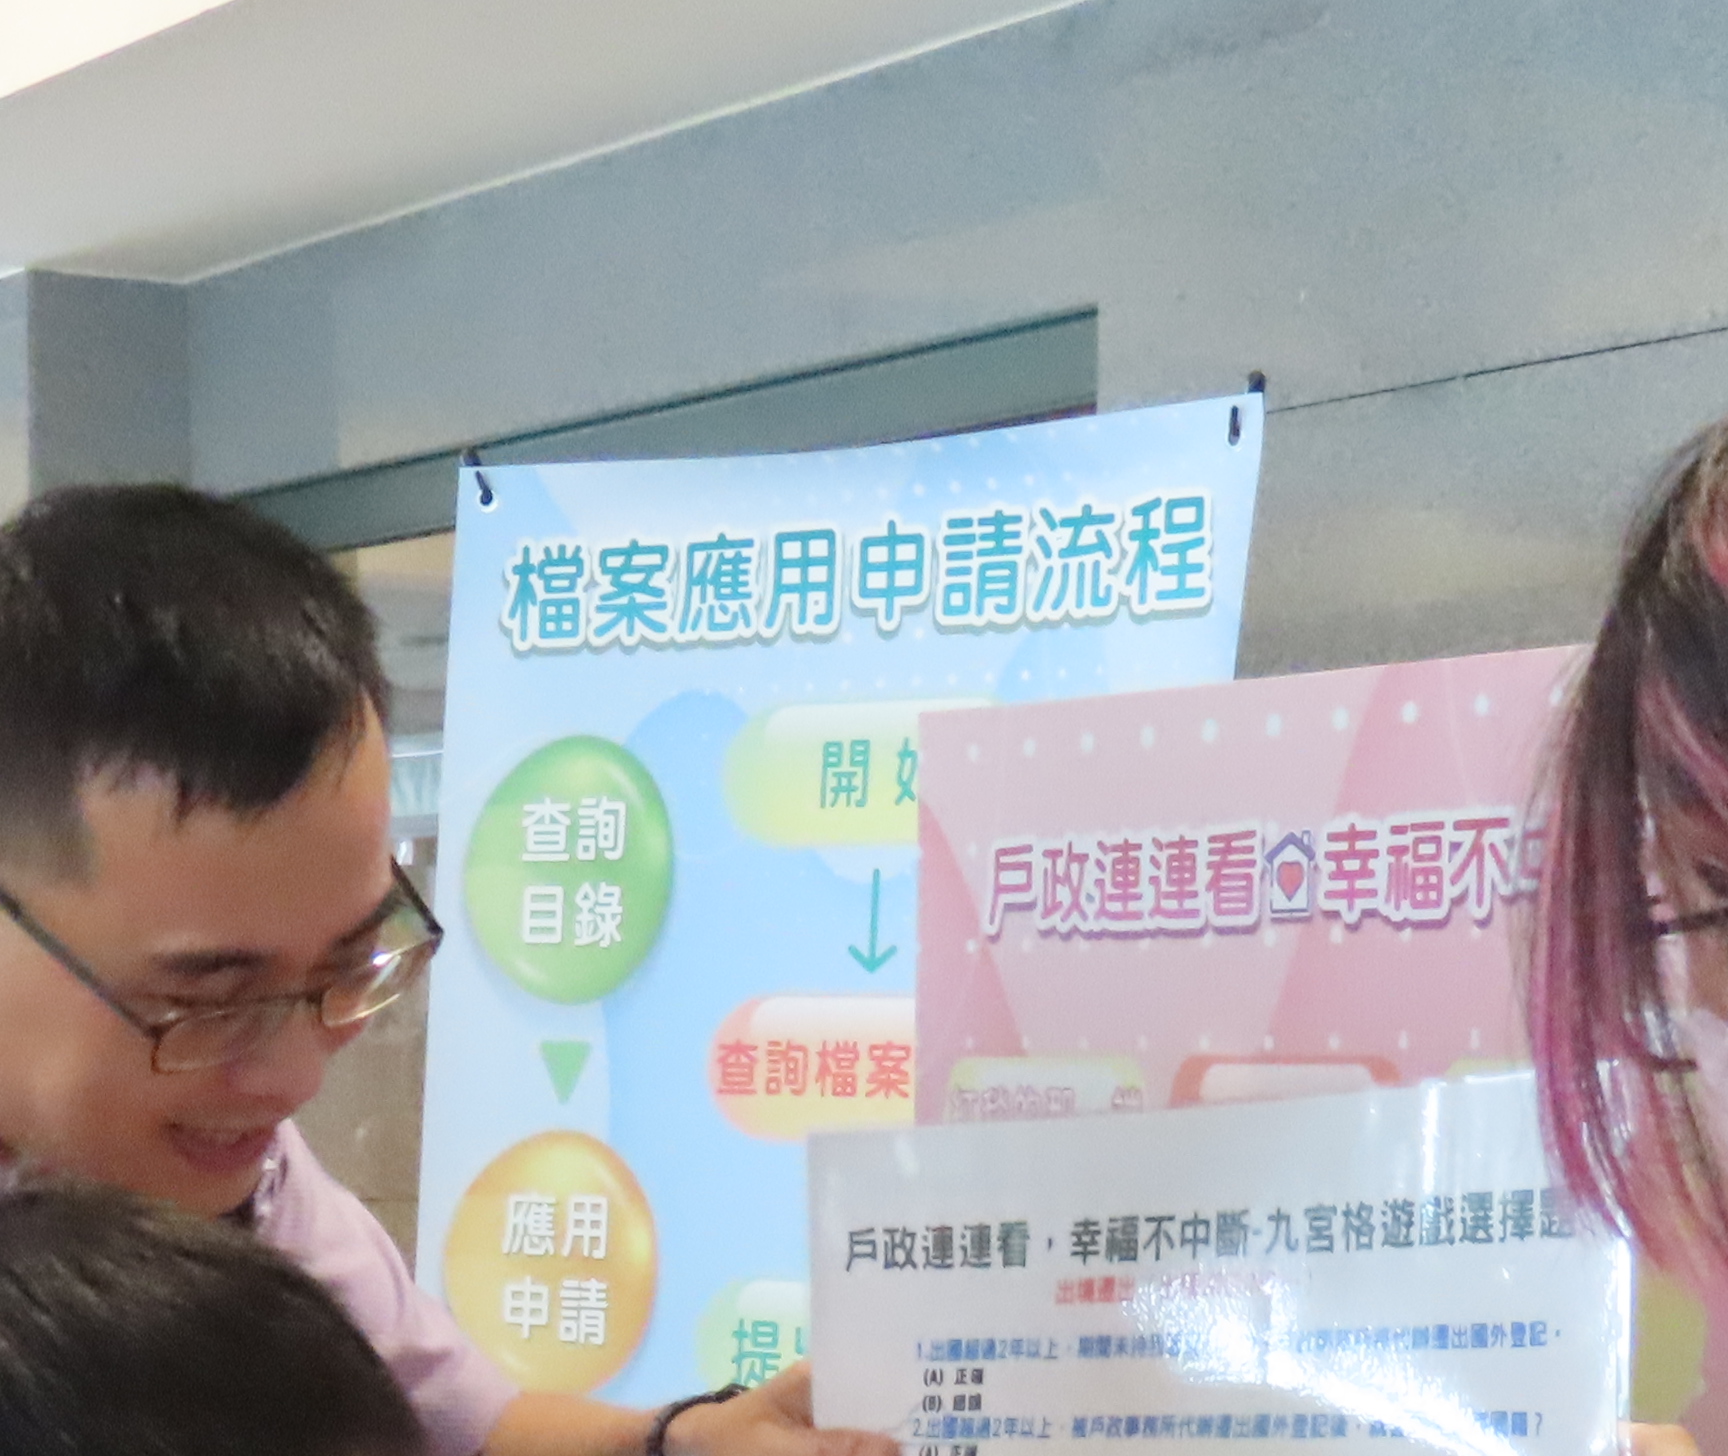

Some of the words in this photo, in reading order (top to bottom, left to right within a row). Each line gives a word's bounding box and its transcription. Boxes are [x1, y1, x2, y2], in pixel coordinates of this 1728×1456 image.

[508, 494, 1212, 642] 檔案應用申請流程
[521, 798, 626, 862] 查詢
[988, 828, 1260, 932] 戶政連連看
[520, 888, 624, 948] 目錄
[716, 1039, 913, 1099] 查詢檔案
[502, 1192, 608, 1260] 應用
[502, 1276, 609, 1345] 申請
